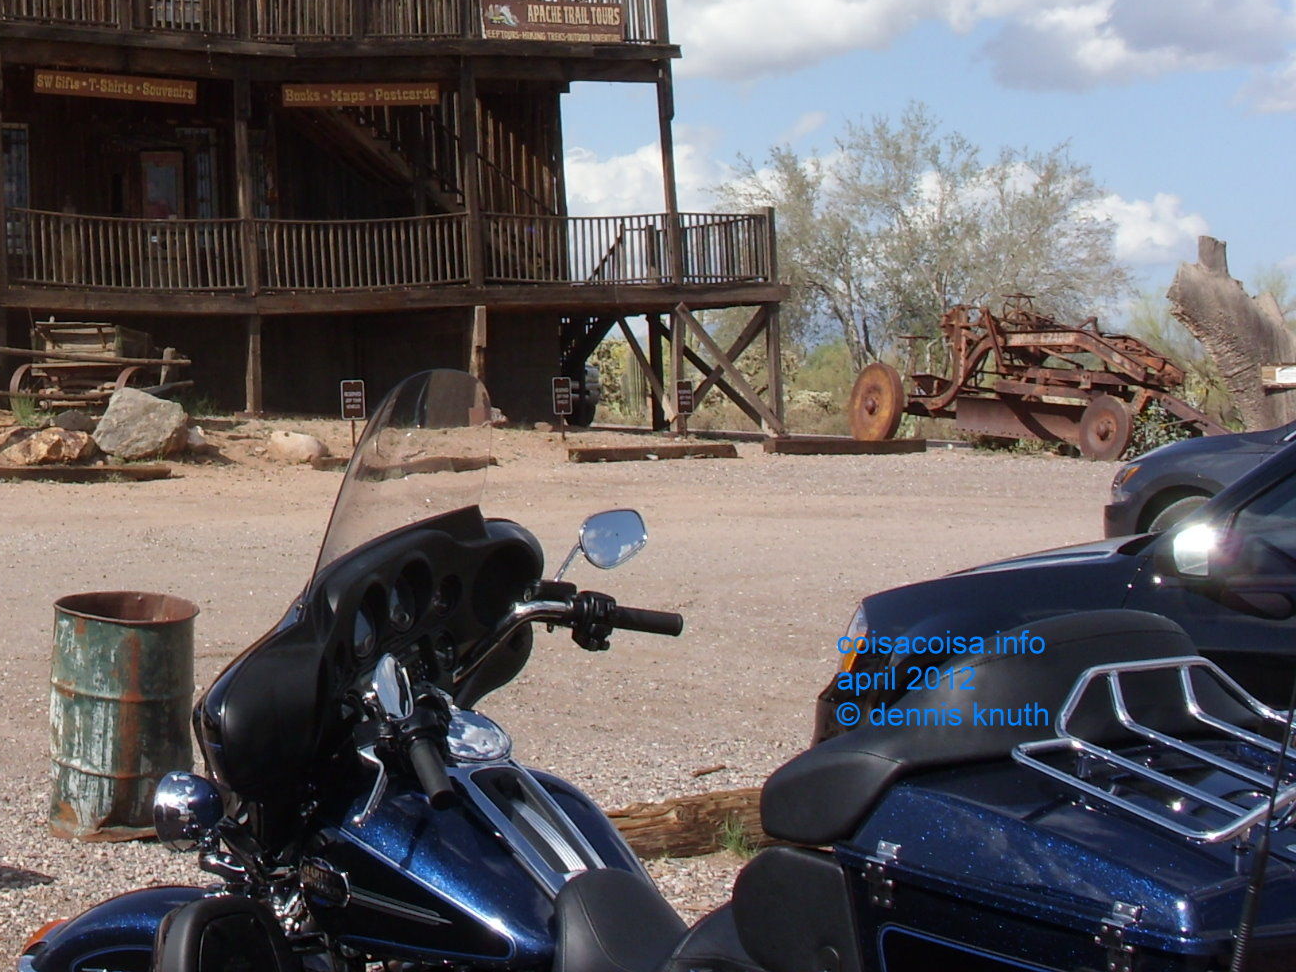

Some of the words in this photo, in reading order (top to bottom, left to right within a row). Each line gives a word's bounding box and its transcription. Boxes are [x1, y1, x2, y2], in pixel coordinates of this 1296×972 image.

[527, 4, 562, 23] APACHE
[564, 5, 589, 25] TRAIL
[591, 7, 620, 26] TOURS
[55, 75, 80, 90] Gifts
[88, 77, 134, 94] T-Shirts
[142, 82, 194, 100] Souvenirs
[285, 89, 320, 102] Books
[330, 89, 366, 103] Maps
[374, 88, 437, 101] Postcards
